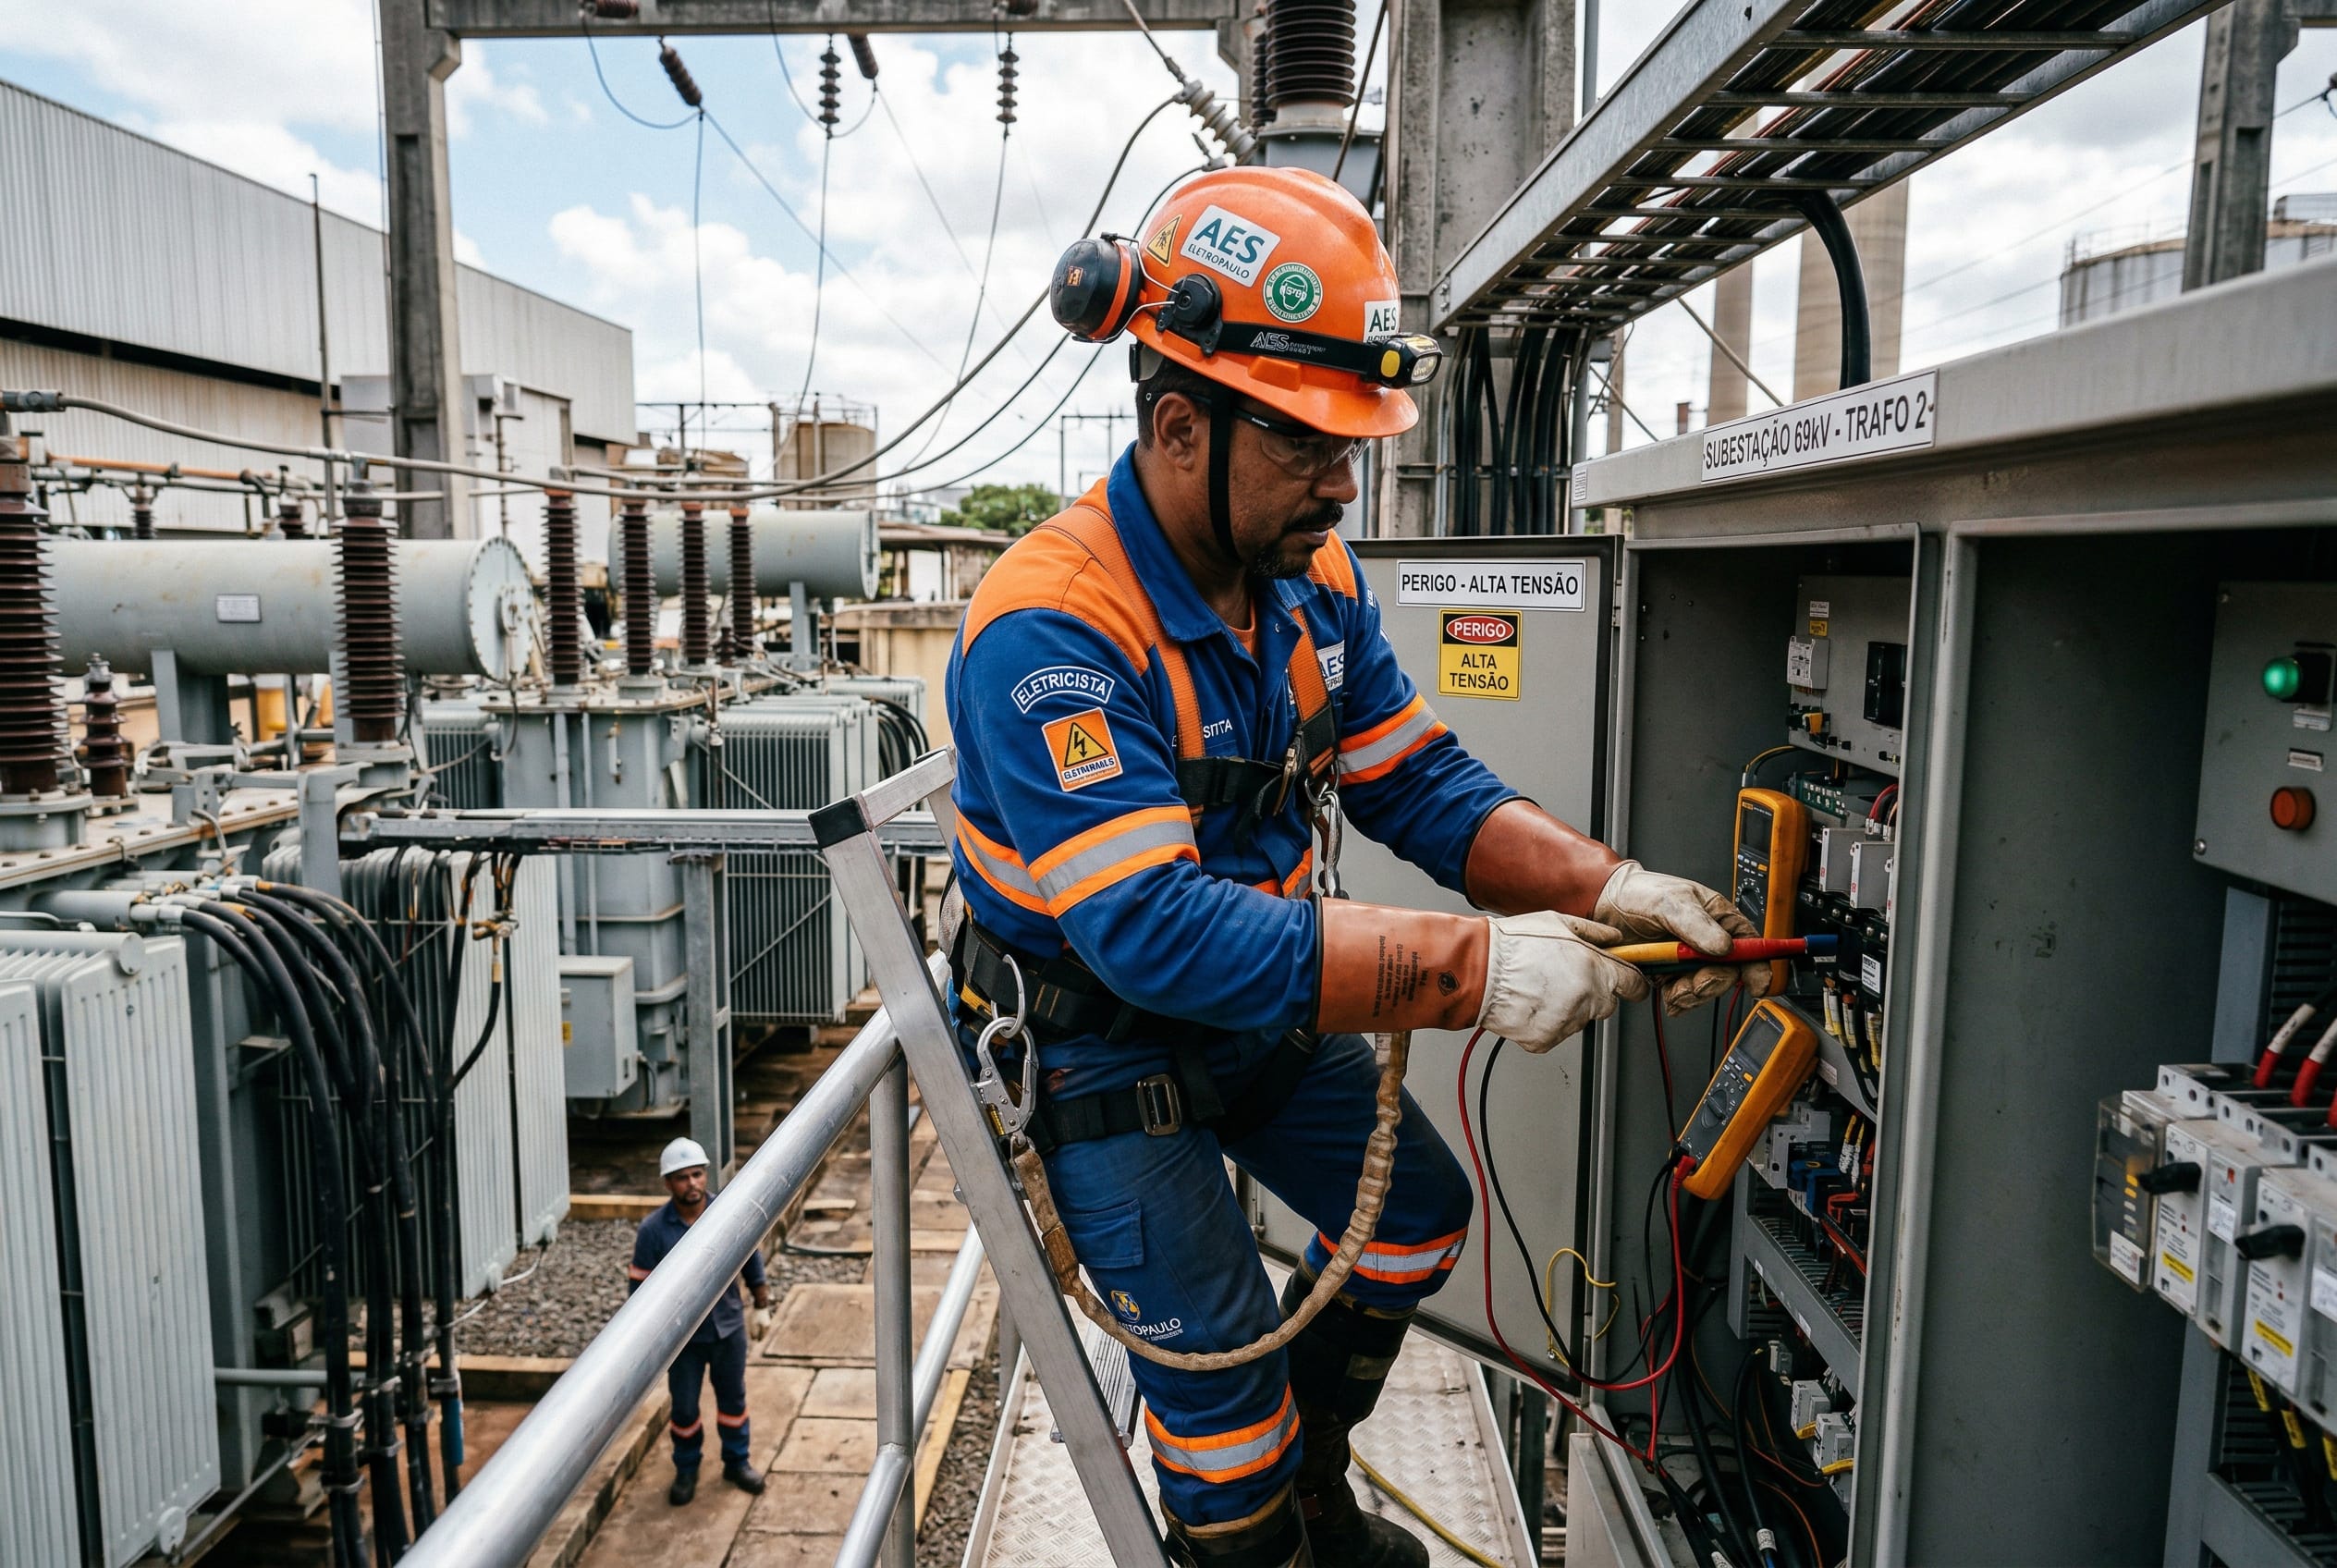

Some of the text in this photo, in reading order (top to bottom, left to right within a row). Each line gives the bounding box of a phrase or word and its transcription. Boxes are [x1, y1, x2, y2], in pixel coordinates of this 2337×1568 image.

[1194, 217, 1266, 264] AES
[1187, 243, 1250, 279] ELETROPAULO
[1369, 306, 1398, 333] AES
[1250, 330, 1291, 353] AES
[1706, 419, 1790, 470] SUBESTAÇÃO
[1794, 412, 1831, 453] 69kV
[1846, 395, 1909, 442] TRAFO
[1915, 390, 1927, 430] 2
[1401, 574, 1457, 592] PERIGO
[1469, 574, 1507, 594] ALTA
[1511, 571, 1579, 595] TENSÃO
[1453, 621, 1506, 638] PERIGO
[1461, 653, 1498, 669] ALTA
[1017, 672, 1106, 705] ELETRICISTA
